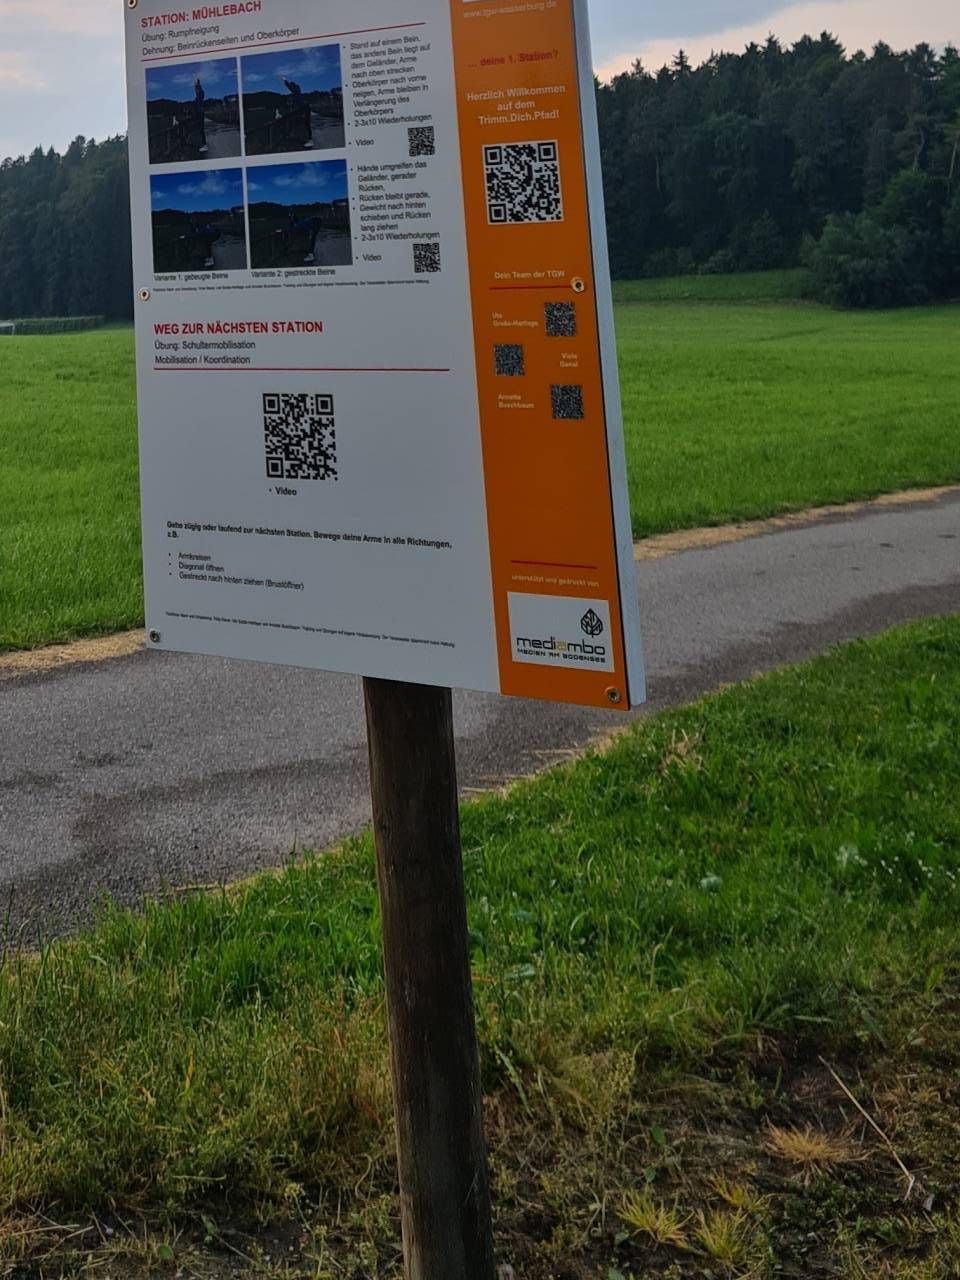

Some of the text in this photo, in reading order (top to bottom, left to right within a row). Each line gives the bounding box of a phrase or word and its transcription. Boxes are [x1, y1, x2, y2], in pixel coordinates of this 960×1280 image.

[141, 0, 262, 28] STATION: MÜHLEBACH
[142, 24, 220, 42] Übung: Rumpfneigung
[142, 27, 301, 56] Dehnung: Beinrückenseiten und Oberkörper
[466, 85, 566, 102] Herzlich Willkommen
[497, 102, 512, 111] auf
[378, 114, 433, 124] Wiederholungen
[355, 138, 375, 146] Video
[362, 254, 382, 262] Video
[494, 271, 511, 279] Dein
[513, 271, 532, 279] Team
[547, 270, 565, 278] TGW
[154, 320, 323, 334] WEG ZUR NÄCHSTEN STATION
[154, 340, 256, 351] Übung: Schultermobilisation
[155, 355, 197, 364] Mobilisation
[203, 355, 251, 364] Koordination
[275, 486, 298, 496] Video
[184, 522, 201, 531] zügig
[203, 523, 217, 531] oder
[218, 524, 242, 533] laufend
[254, 526, 285, 536] nächsten
[313, 531, 341, 541] Bewege
[363, 534, 382, 543] Arme
[562, 653, 606, 663] BODENSEE
